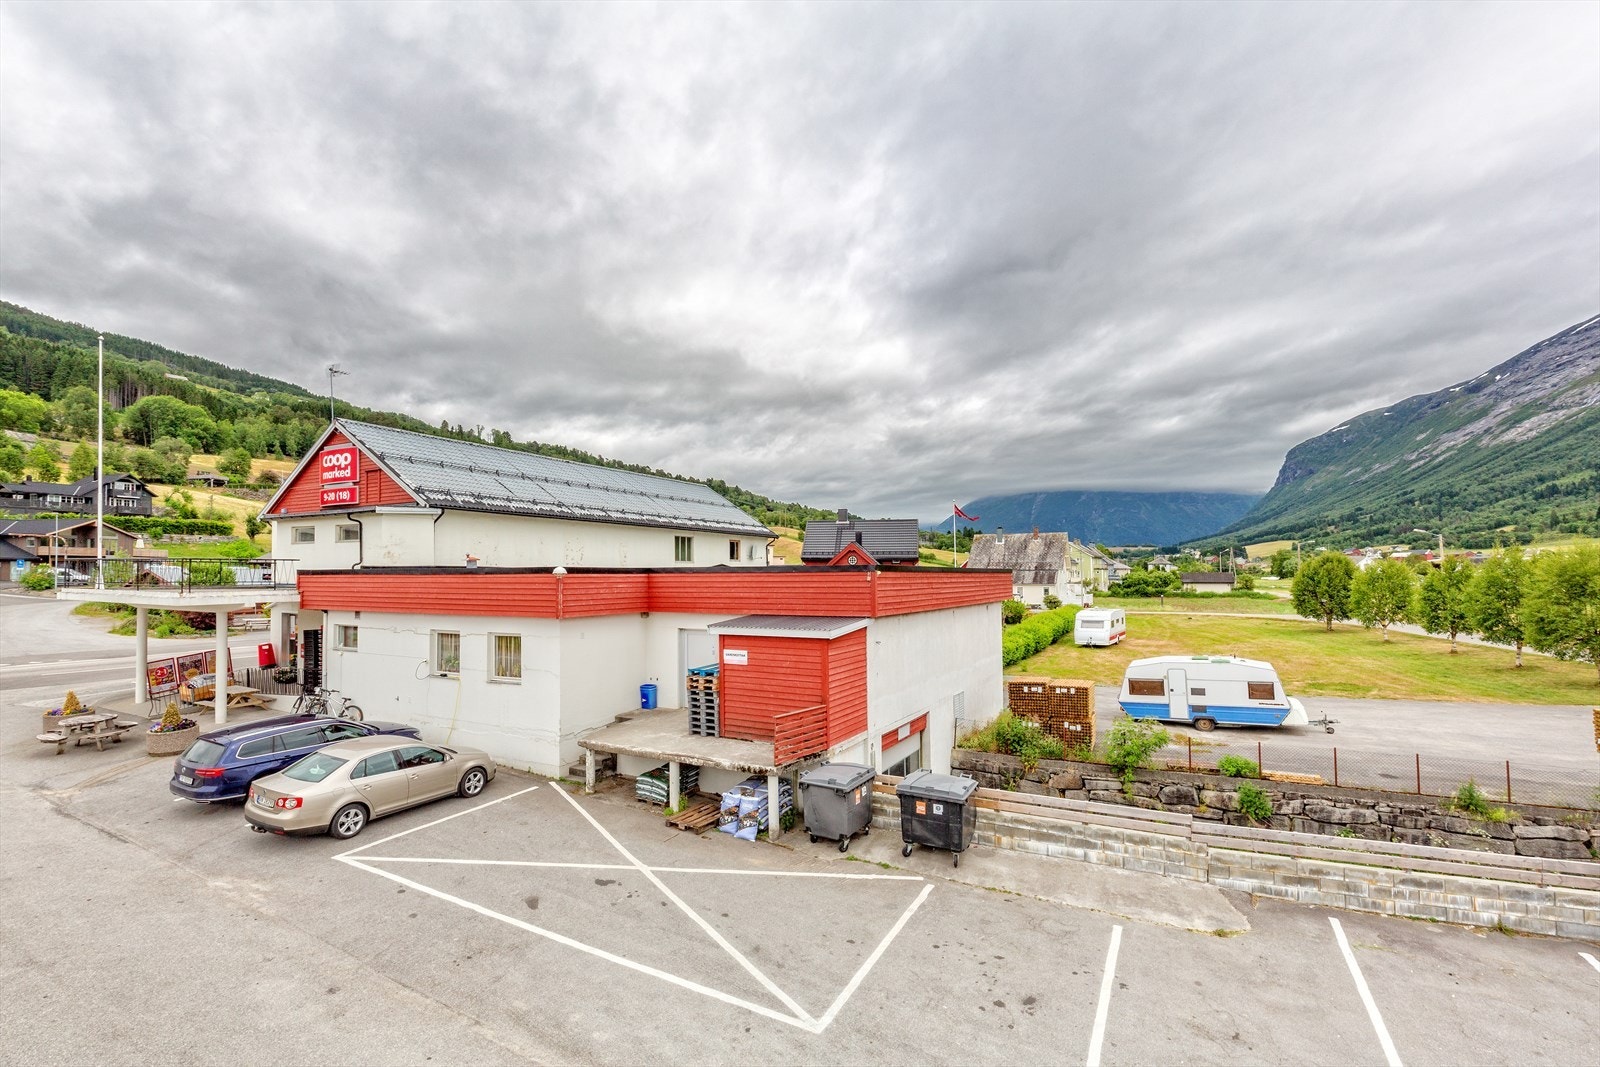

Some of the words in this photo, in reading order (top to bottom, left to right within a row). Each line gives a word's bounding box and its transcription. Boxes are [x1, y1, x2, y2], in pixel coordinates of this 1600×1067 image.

[322, 453, 352, 468] coop
[322, 466, 351, 480] marked
[323, 492, 335, 501] 9-20
[336, 491, 350, 501] (18)
